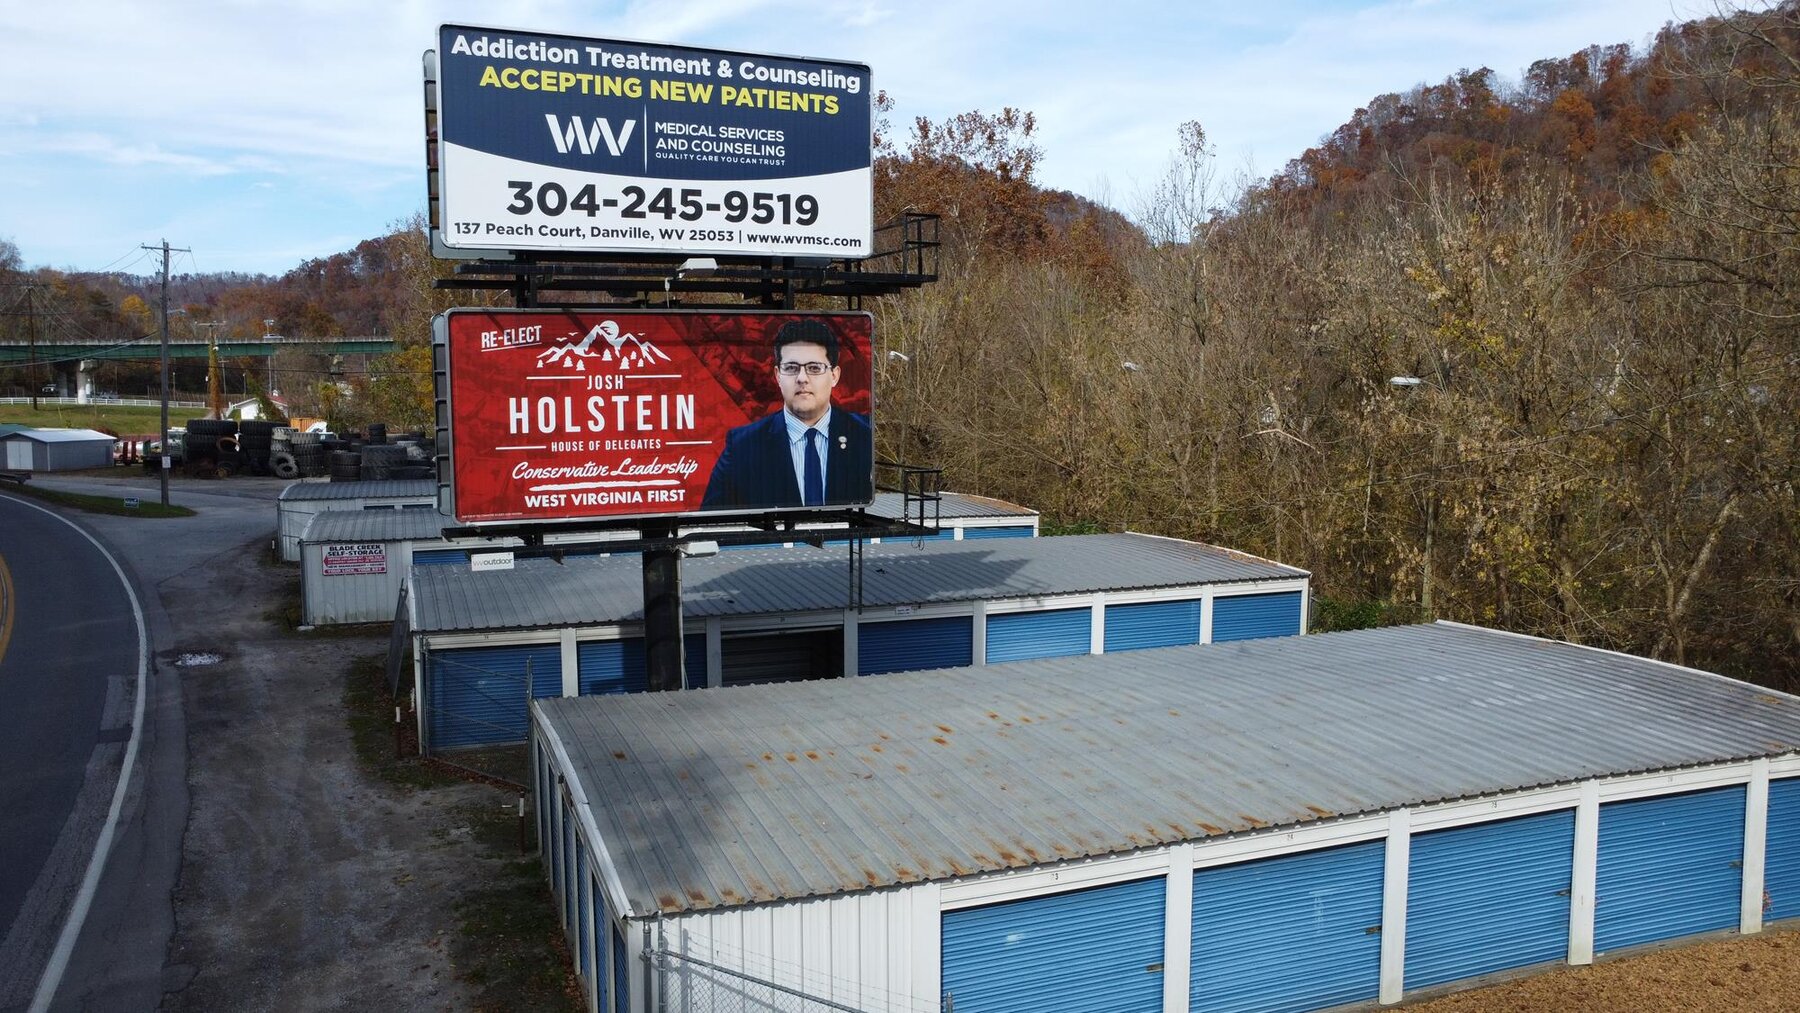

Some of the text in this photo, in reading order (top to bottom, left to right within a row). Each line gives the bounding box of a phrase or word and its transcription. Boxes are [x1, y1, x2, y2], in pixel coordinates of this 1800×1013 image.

[451, 35, 861, 94] Addiction Treatment & Counseling
[479, 66, 840, 115] ACCEPTING NEW PATIENTS
[655, 121, 785, 142] MEDICAL SERVICES
[655, 138, 786, 157] AND COUNSELING
[655, 152, 694, 161] QUALITY
[696, 154, 719, 162] CARE
[740, 157, 757, 165] CAN
[759, 158, 786, 166] TRUST
[506, 180, 819, 226] 304-245-9519
[454, 222, 481, 234] 137
[486, 223, 534, 236] Peach
[538, 224, 586, 239] Court,
[590, 226, 655, 241] Danville,
[659, 228, 685, 240] WV
[689, 229, 734, 242] 25053
[746, 233, 862, 248] www.wvmsc.com
[481, 325, 542, 349] RE-ELECT
[587, 374, 624, 390] JOSH
[508, 394, 695, 434] HOLSTEIN
[551, 439, 661, 452] HOUSE OF DELEGATES
[512, 455, 699, 480] Conservative Leadership
[524, 489, 686, 508] WEST VIRGINIA FIRST
